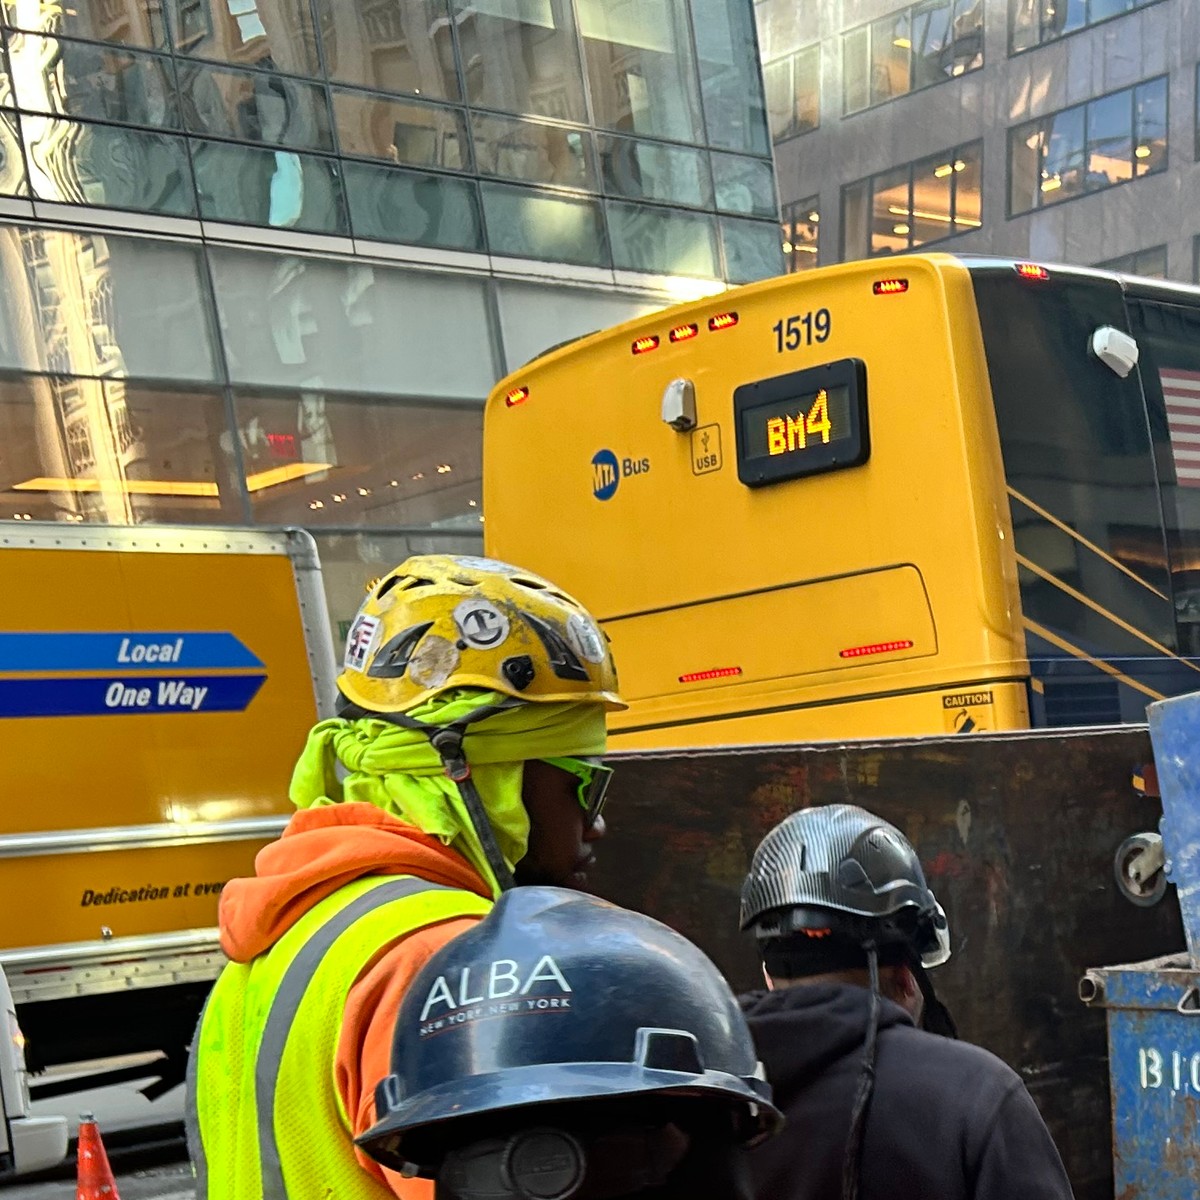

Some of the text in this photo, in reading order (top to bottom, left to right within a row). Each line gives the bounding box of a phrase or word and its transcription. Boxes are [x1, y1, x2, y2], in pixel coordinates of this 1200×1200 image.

[773, 307, 831, 353] 1519
[767, 387, 832, 457] BM4
[622, 456, 651, 478] Bus
[695, 454, 718, 470] USB
[117, 638, 184, 663] Local
[104, 680, 208, 711] One Way
[944, 693, 992, 707] CAUTION
[80, 883, 169, 908] Dedication
[173, 882, 190, 898] at
[419, 954, 573, 1023] ALBA
[527, 997, 571, 1010] YORK
